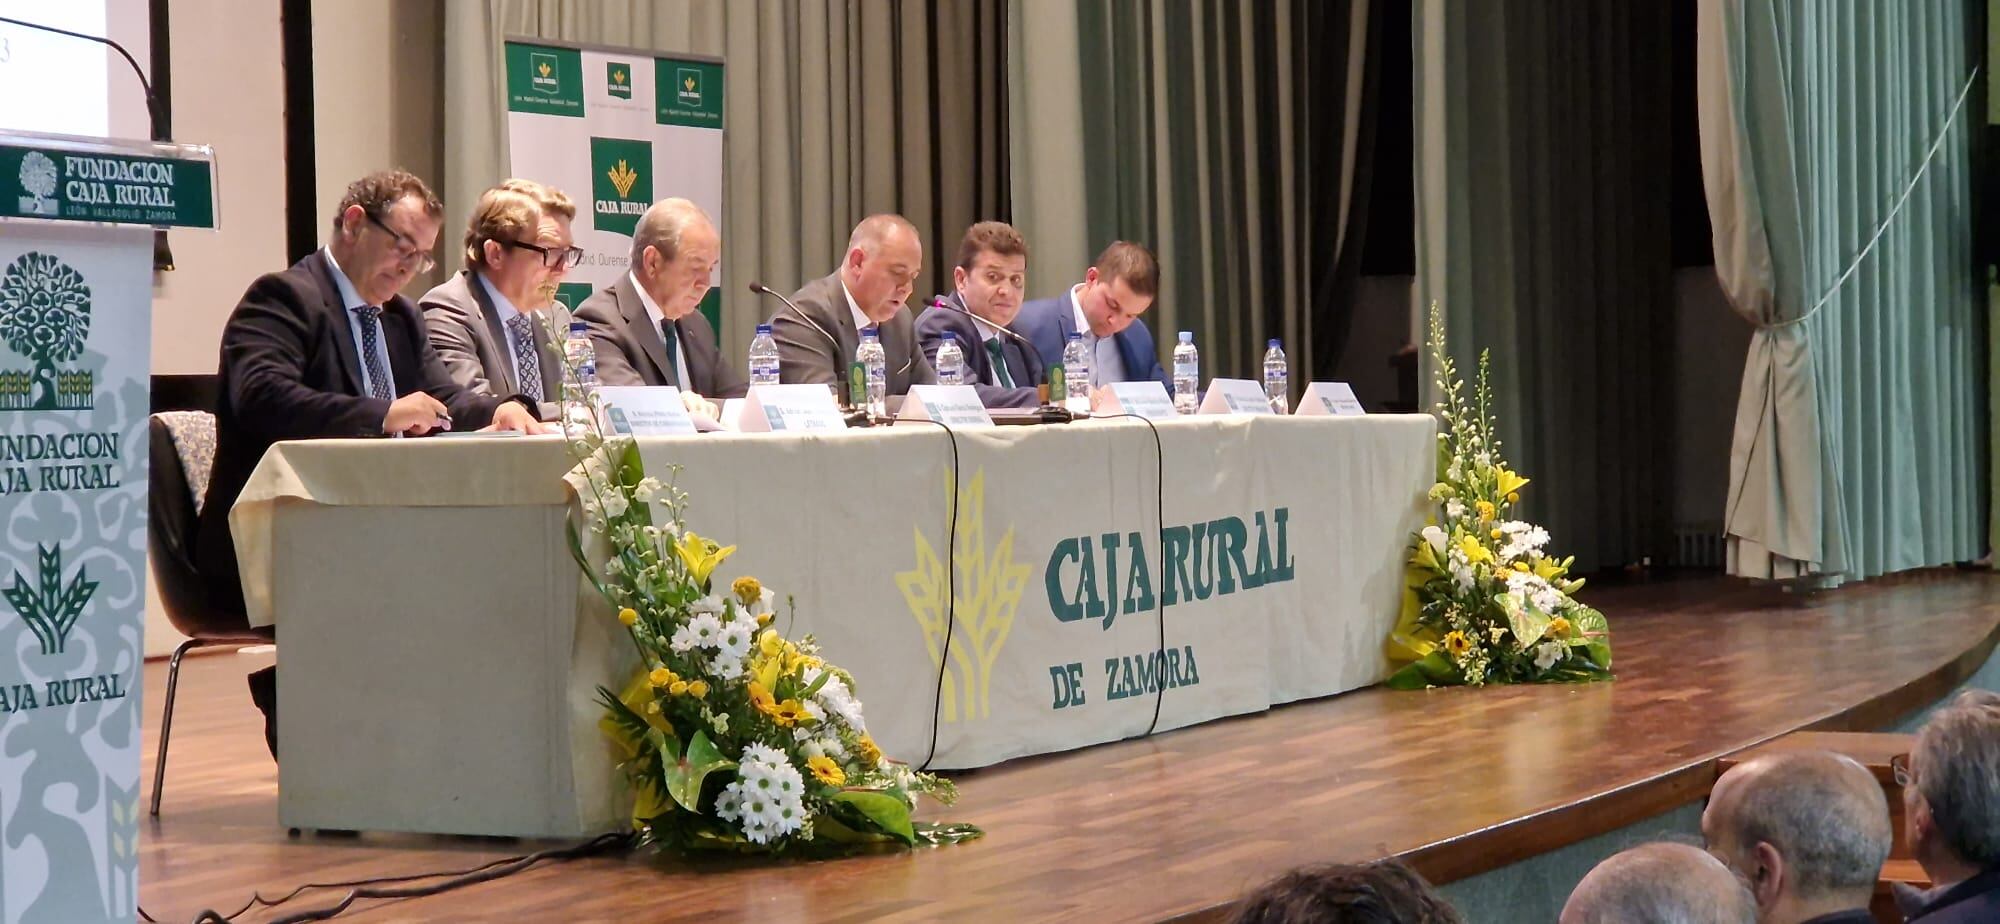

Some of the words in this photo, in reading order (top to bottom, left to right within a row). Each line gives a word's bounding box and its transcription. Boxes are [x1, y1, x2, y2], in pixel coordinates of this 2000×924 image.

[64, 156, 174, 185] FUNDACION
[66, 181, 111, 205] CAJA
[114, 184, 175, 207] RURAL
[595, 200, 619, 215] CAJA
[0, 432, 119, 462] NDACION
[0, 466, 32, 496] JA
[39, 464, 119, 491] RURAL
[1045, 532, 1155, 631] CAJA
[1160, 507, 1295, 606] RURAL
[46, 674, 125, 707] RURAL
[1050, 662, 1086, 709] DE
[1105, 645, 1200, 701] ZAMORA
